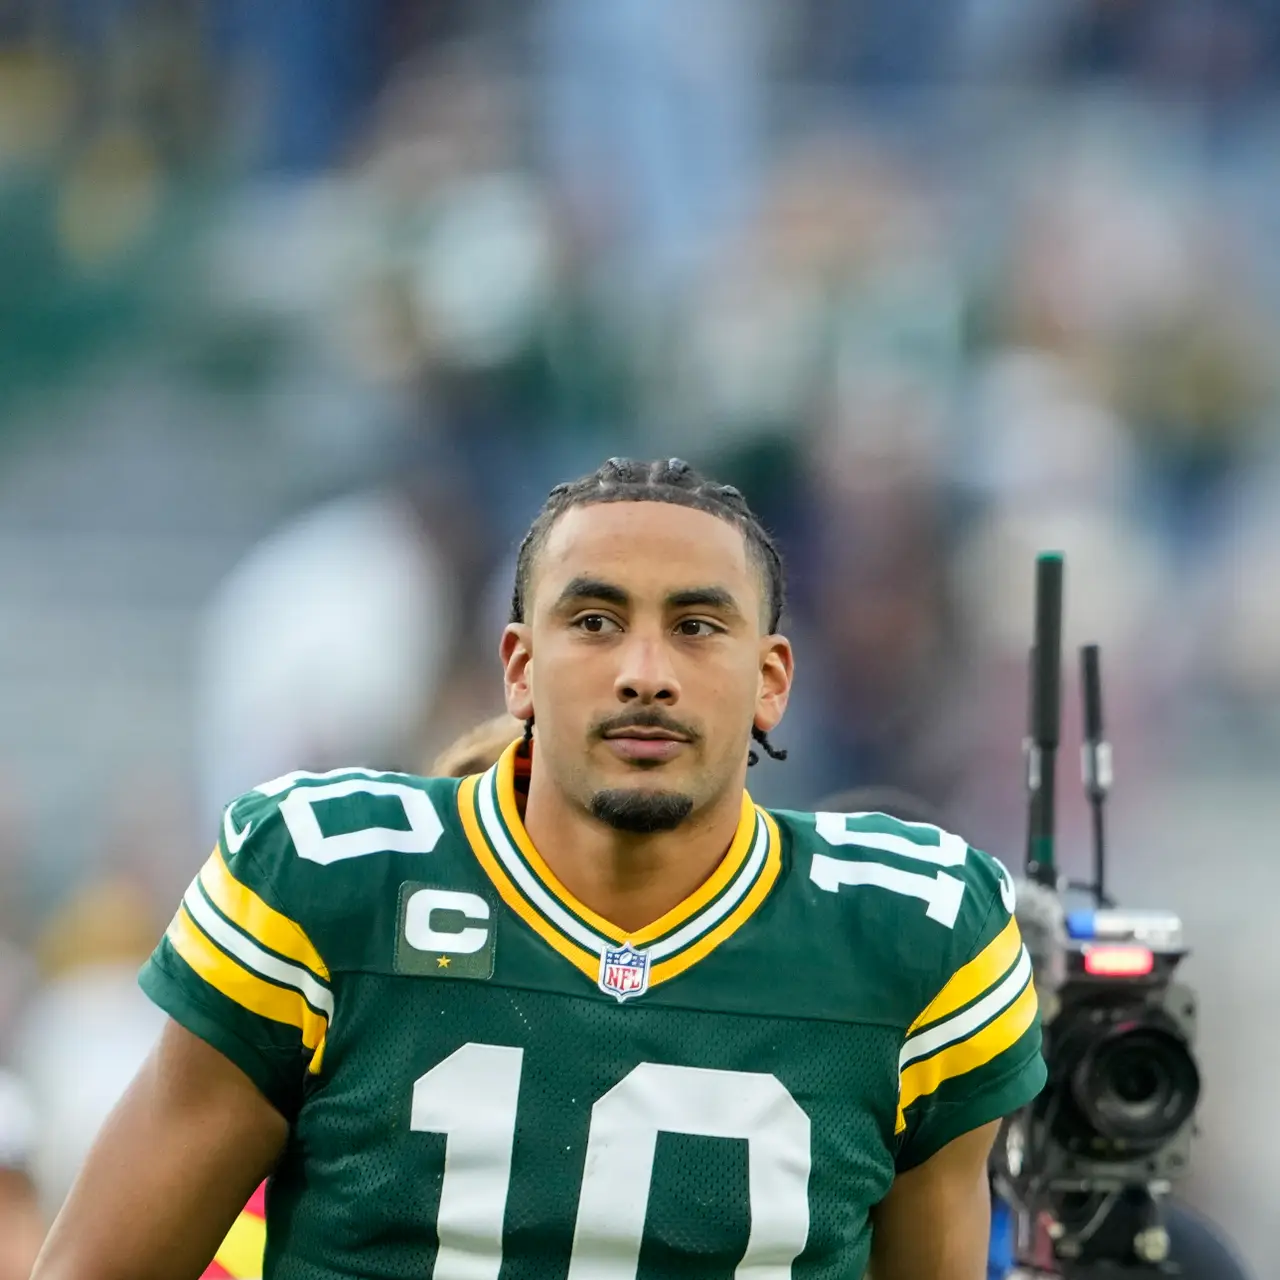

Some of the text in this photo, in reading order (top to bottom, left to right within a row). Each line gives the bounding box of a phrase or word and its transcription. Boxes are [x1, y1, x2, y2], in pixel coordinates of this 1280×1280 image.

[809, 811, 968, 930] 10
[404, 888, 490, 954] C
[606, 966, 640, 991] NFL
